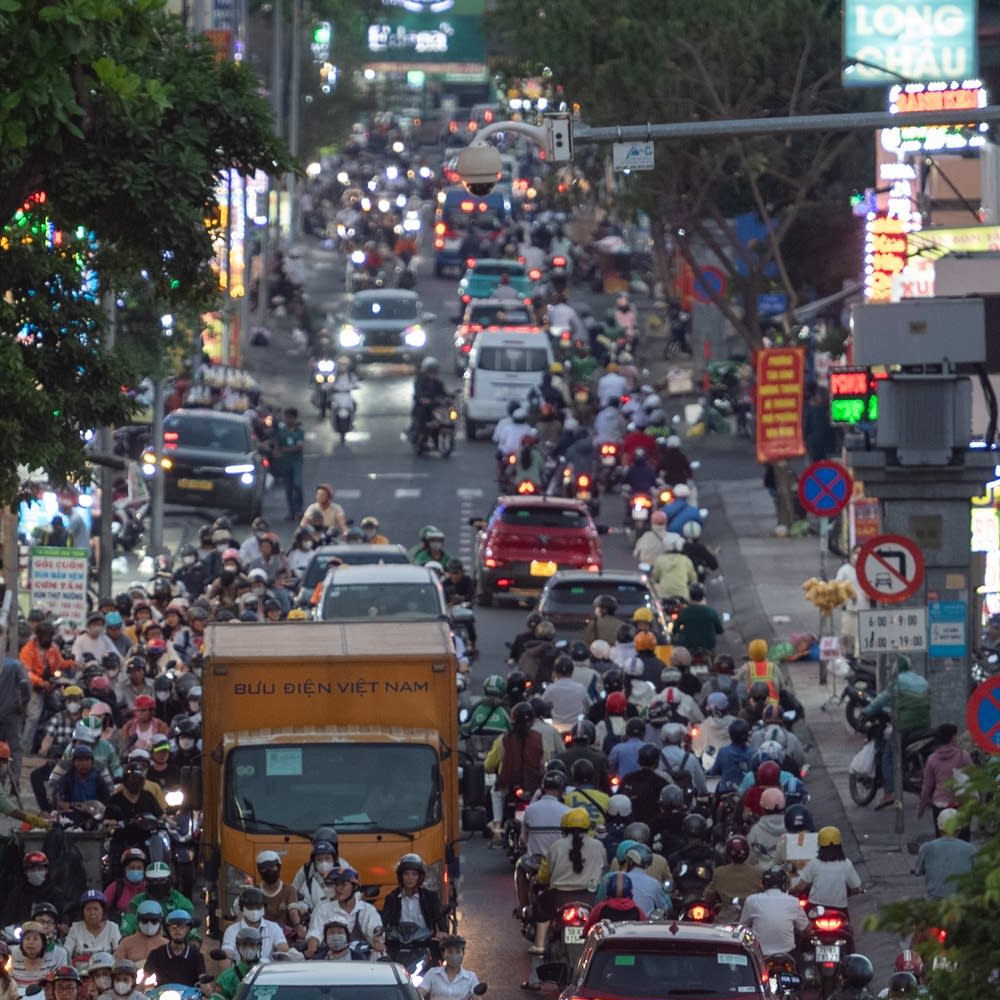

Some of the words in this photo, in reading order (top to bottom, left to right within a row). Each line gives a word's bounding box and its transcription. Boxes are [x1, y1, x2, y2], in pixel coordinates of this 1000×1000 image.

[855, 4, 966, 37] LONG
[855, 38, 967, 79] CHÂU
[283, 678, 331, 698] ĐIỆN
[337, 678, 379, 697] VIỆT
[385, 681, 429, 693] NAM
